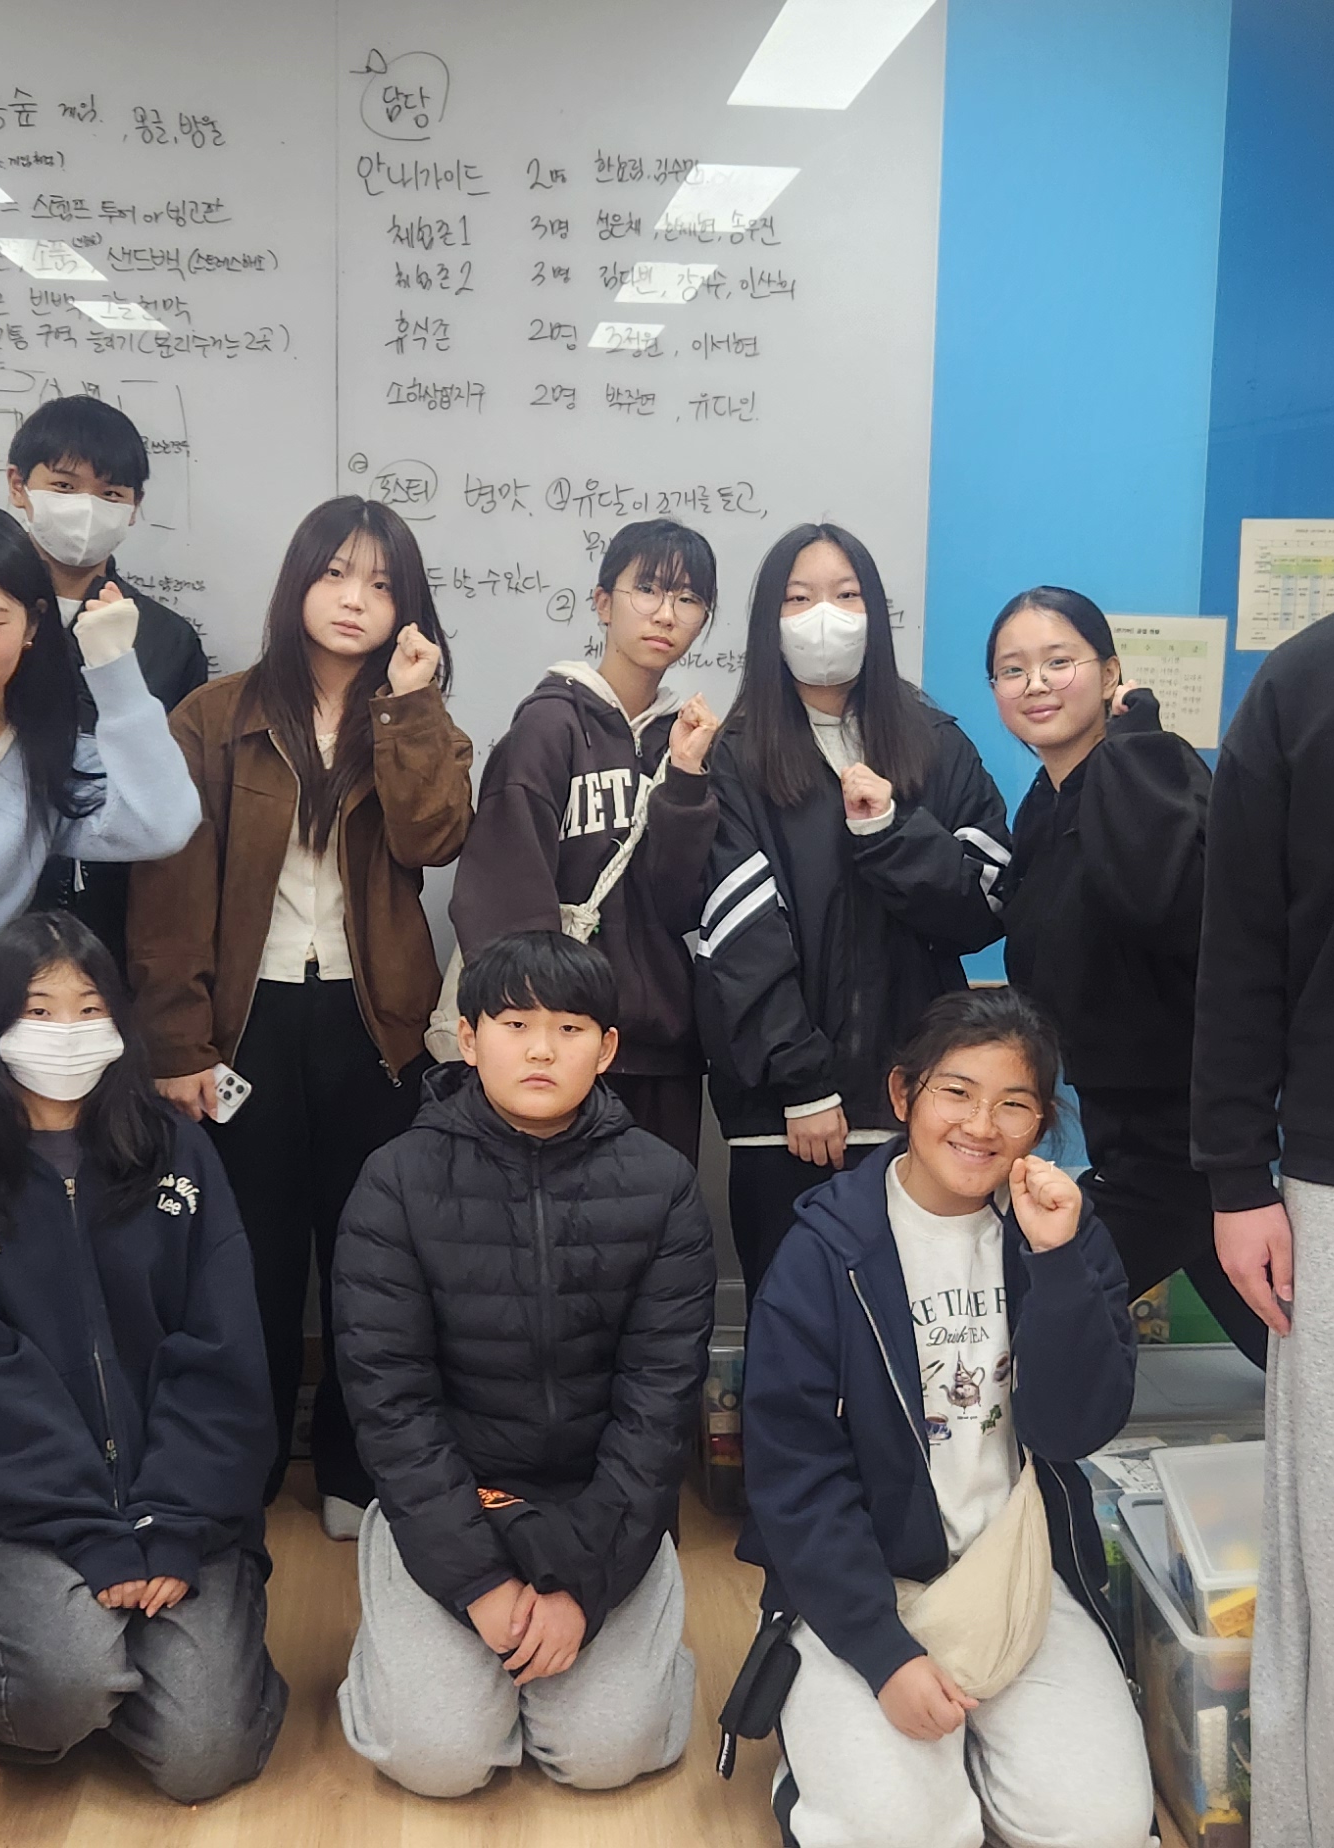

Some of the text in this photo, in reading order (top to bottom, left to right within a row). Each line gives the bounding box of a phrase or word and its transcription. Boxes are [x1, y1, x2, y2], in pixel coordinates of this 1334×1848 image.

[383, 85, 431, 129] 담당
[530, 215, 570, 240] 3명
[530, 261, 571, 287] 3명
[384, 309, 451, 355] 휴식존
[527, 318, 578, 351] 2명
[529, 384, 576, 411] 2명
